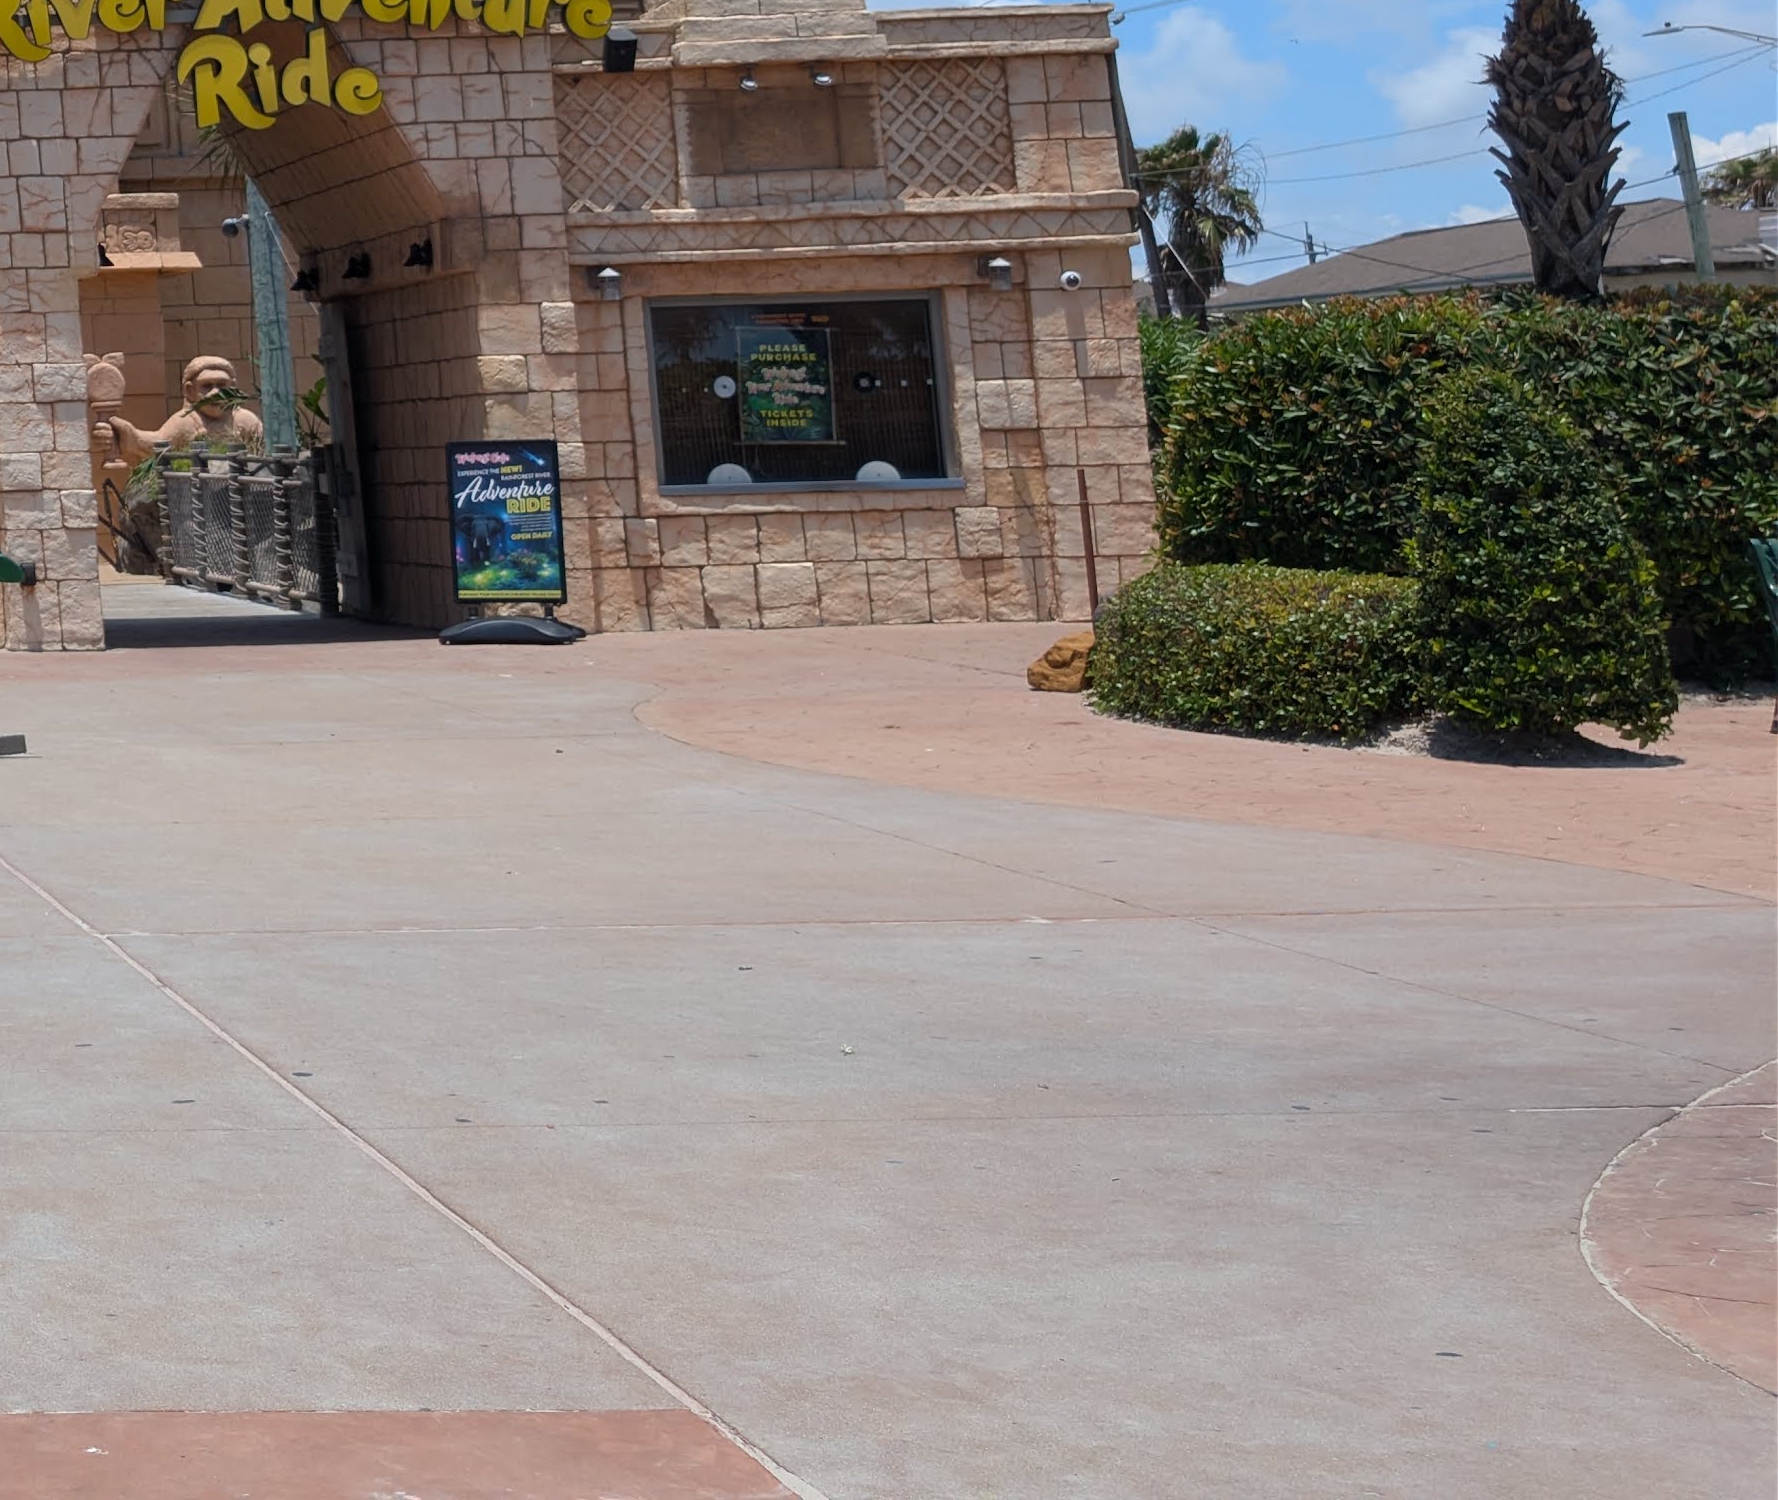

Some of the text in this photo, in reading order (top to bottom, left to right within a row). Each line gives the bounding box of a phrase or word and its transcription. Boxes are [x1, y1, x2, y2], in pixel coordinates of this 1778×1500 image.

[177, 28, 384, 130] Ride
[759, 344, 806, 352] PLEASE
[750, 353, 817, 361] PURCHASE
[760, 410, 813, 418] TICKETS
[766, 419, 808, 427] INSIDE
[457, 468, 488, 477] EXPERIENCE
[454, 476, 555, 508] Adventure
[506, 496, 551, 514] RIDE
[511, 531, 552, 540] OPEN DAILY
